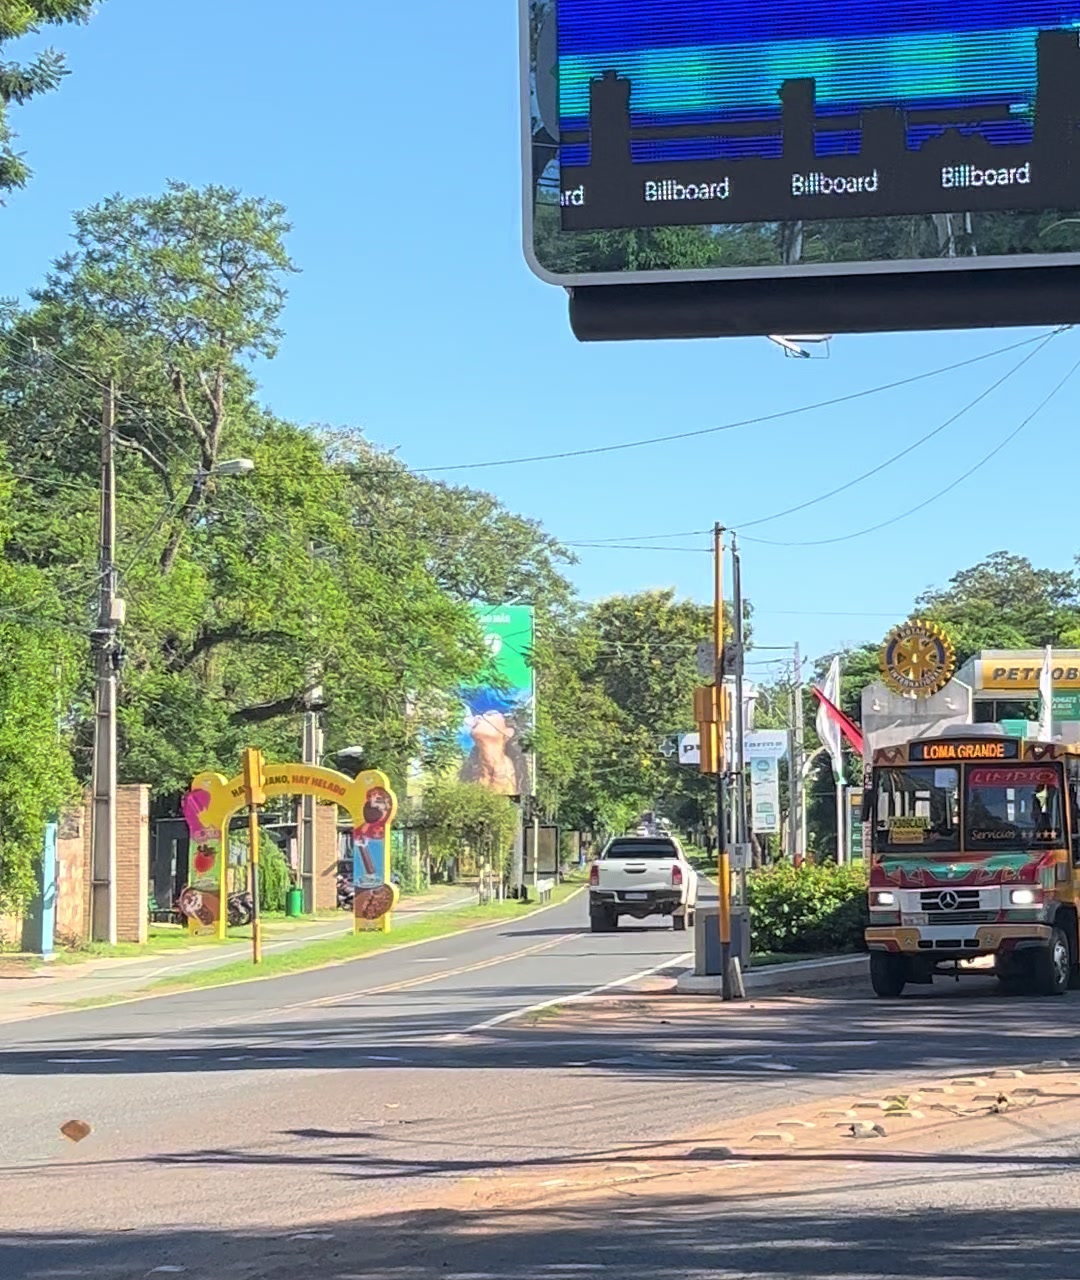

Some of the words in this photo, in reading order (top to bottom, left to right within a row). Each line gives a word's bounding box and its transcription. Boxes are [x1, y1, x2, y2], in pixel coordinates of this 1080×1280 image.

[644, 177, 730, 201] Billboard
[791, 169, 879, 196] Billboard
[941, 162, 1031, 188] Billboard
[923, 745, 955, 759] LOMA
[957, 743, 1005, 758] GRANDE
[974, 771, 1054, 783] LIMPIO
[311, 777, 346, 797] HELADO
[971, 829, 1016, 841] Servicios
